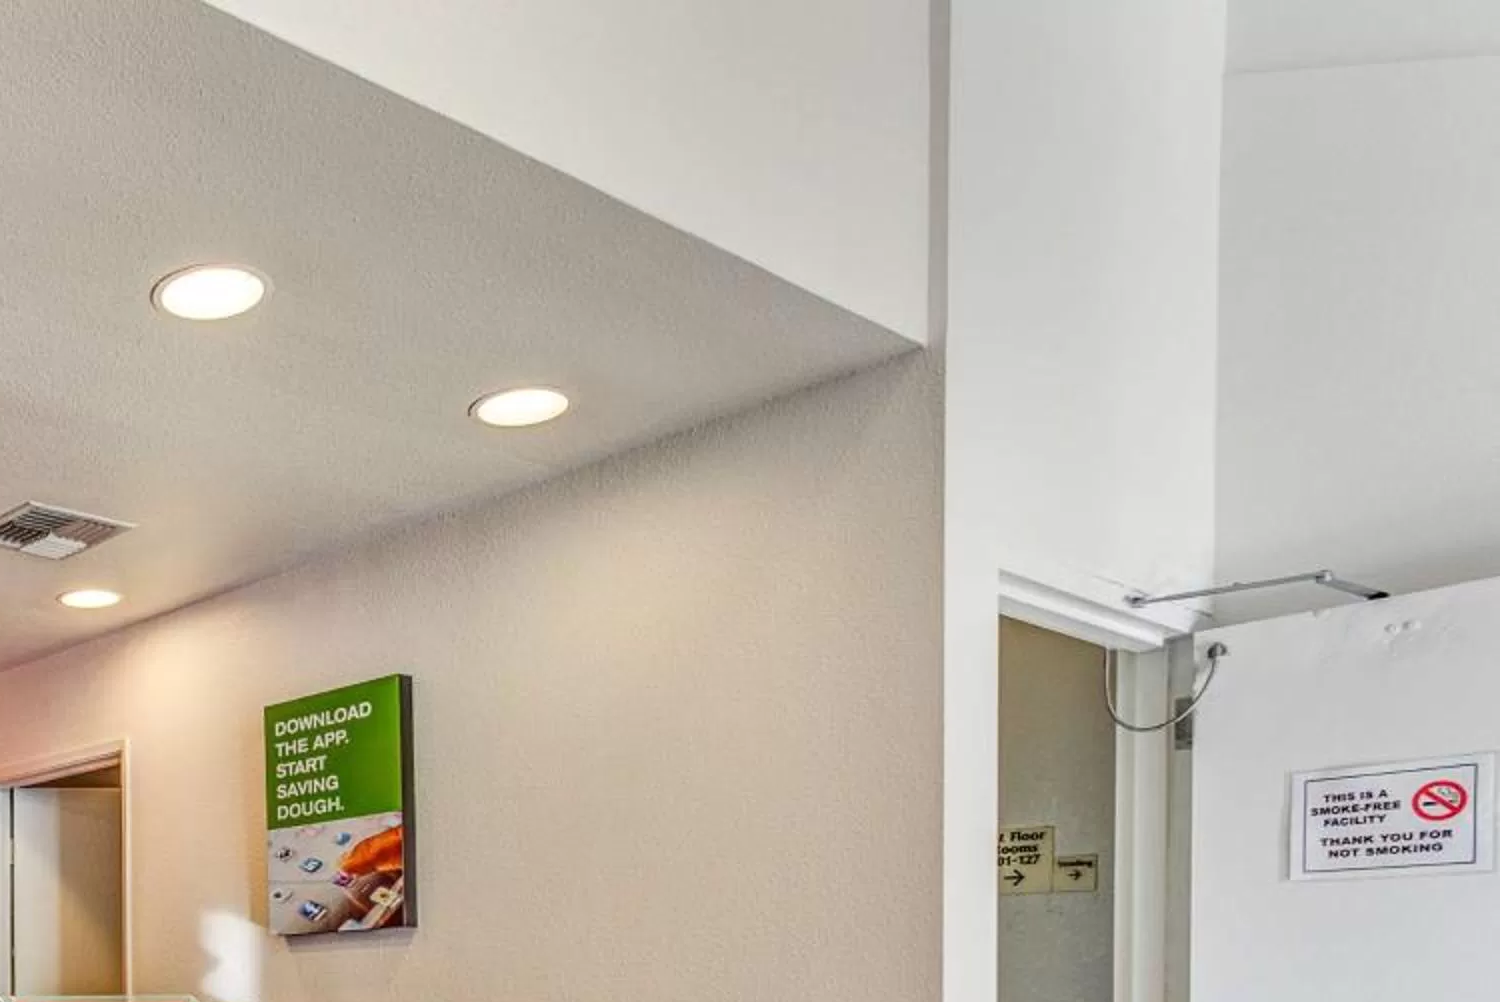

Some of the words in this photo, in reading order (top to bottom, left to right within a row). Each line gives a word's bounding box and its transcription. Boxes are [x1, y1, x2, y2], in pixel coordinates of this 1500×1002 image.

[274, 701, 372, 737] DOWNLOAD
[275, 738, 309, 757] THE
[312, 729, 350, 751] APP.
[276, 755, 328, 778] START
[276, 775, 339, 800] SAVING
[1323, 792, 1355, 803] THIS
[1360, 791, 1373, 800] IS
[1378, 789, 1388, 799] A
[277, 797, 345, 821] DOUGH.
[1310, 800, 1401, 816] SMOKE-FREE
[1323, 814, 1387, 827] FACILITY
[1320, 835, 1374, 847] THANK
[1381, 831, 1413, 843] YOU
[1419, 829, 1453, 840] FOR
[998, 845, 1038, 854] ooms
[1328, 847, 1359, 859] NOT
[1365, 842, 1443, 858] SMOKING
